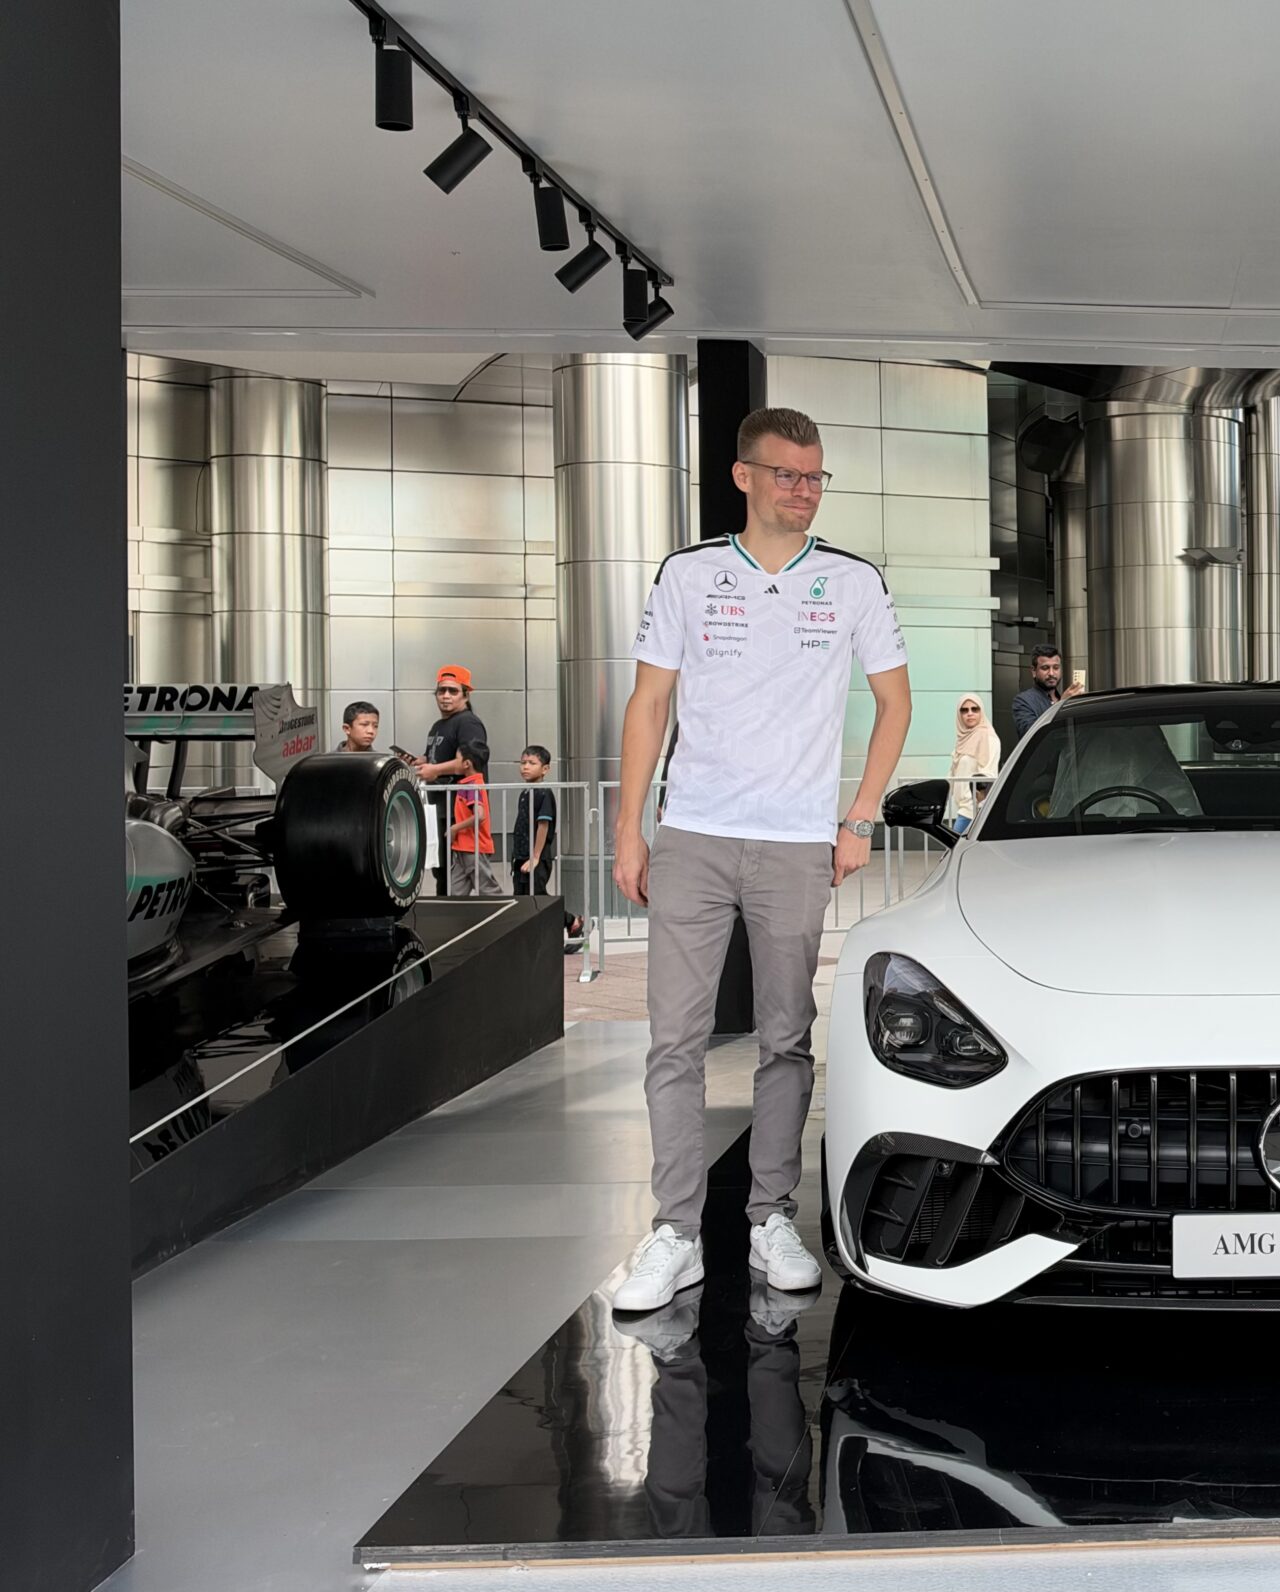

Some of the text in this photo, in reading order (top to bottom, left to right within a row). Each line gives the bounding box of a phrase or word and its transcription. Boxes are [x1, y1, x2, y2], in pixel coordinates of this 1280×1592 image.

[720, 605, 745, 616] UBS
[797, 611, 836, 622] INEOS
[704, 620, 748, 628] CROWDSTRIKE
[800, 626, 838, 635] TeamViewer
[712, 634, 747, 642] Snapdragon
[800, 640, 830, 650] HPE
[282, 734, 316, 758] aabar
[1212, 1232, 1276, 1256] AMG
